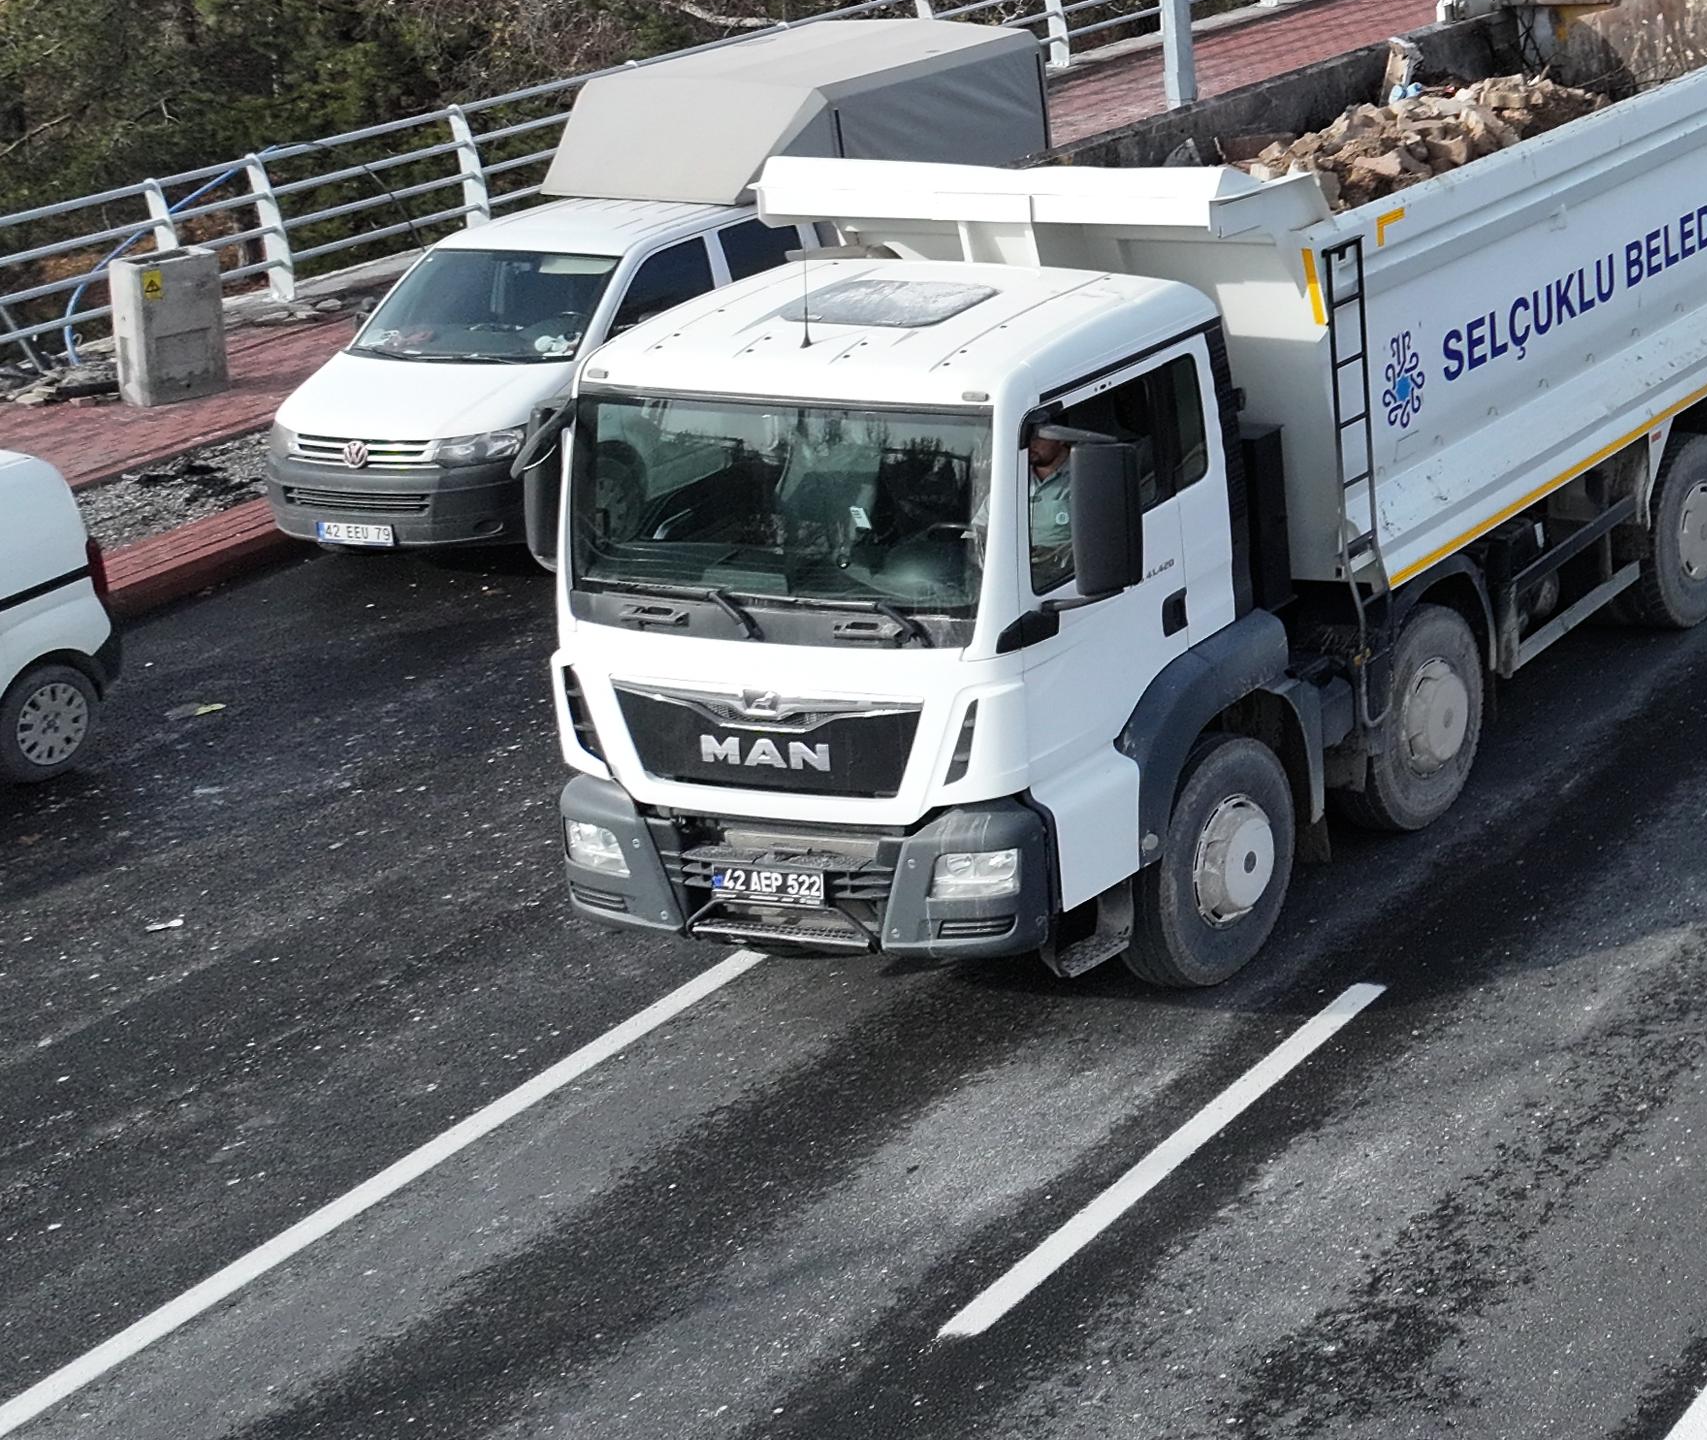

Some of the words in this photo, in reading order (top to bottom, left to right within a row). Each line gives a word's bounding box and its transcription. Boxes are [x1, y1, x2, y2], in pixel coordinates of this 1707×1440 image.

[1442, 253, 1616, 382] SELÇUKLU
[326, 524, 341, 538] 42
[346, 526, 369, 540] EEU
[374, 527, 391, 541] 79
[699, 733, 832, 773] MAN
[723, 868, 747, 891] 42
[750, 871, 783, 893] AEP
[786, 874, 822, 897] 522
